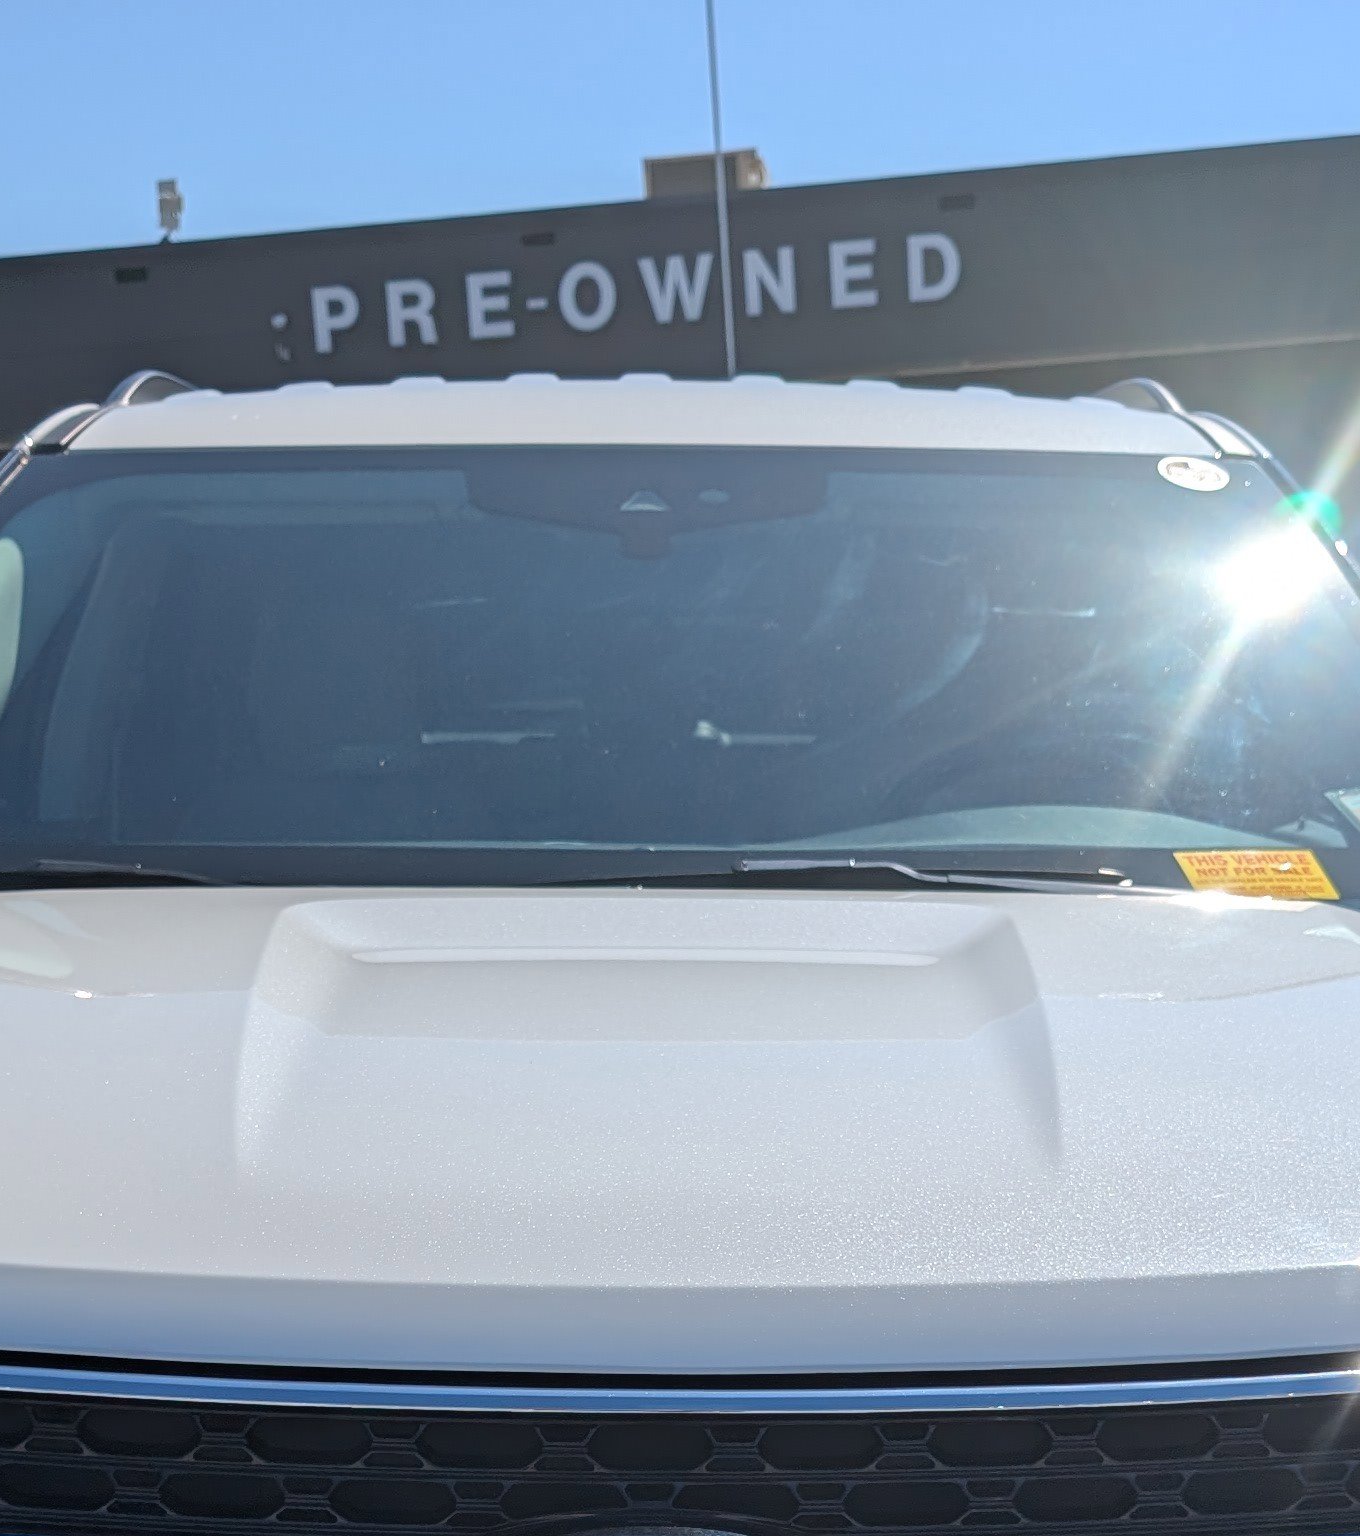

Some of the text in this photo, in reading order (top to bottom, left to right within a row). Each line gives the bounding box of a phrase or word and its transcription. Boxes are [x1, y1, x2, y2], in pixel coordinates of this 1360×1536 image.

[310, 233, 962, 353] PRE-OWNED
[1182, 854, 1310, 866] THIS VEHICLE
[1195, 867, 1229, 877] NOT
[1233, 867, 1268, 876] FOR
